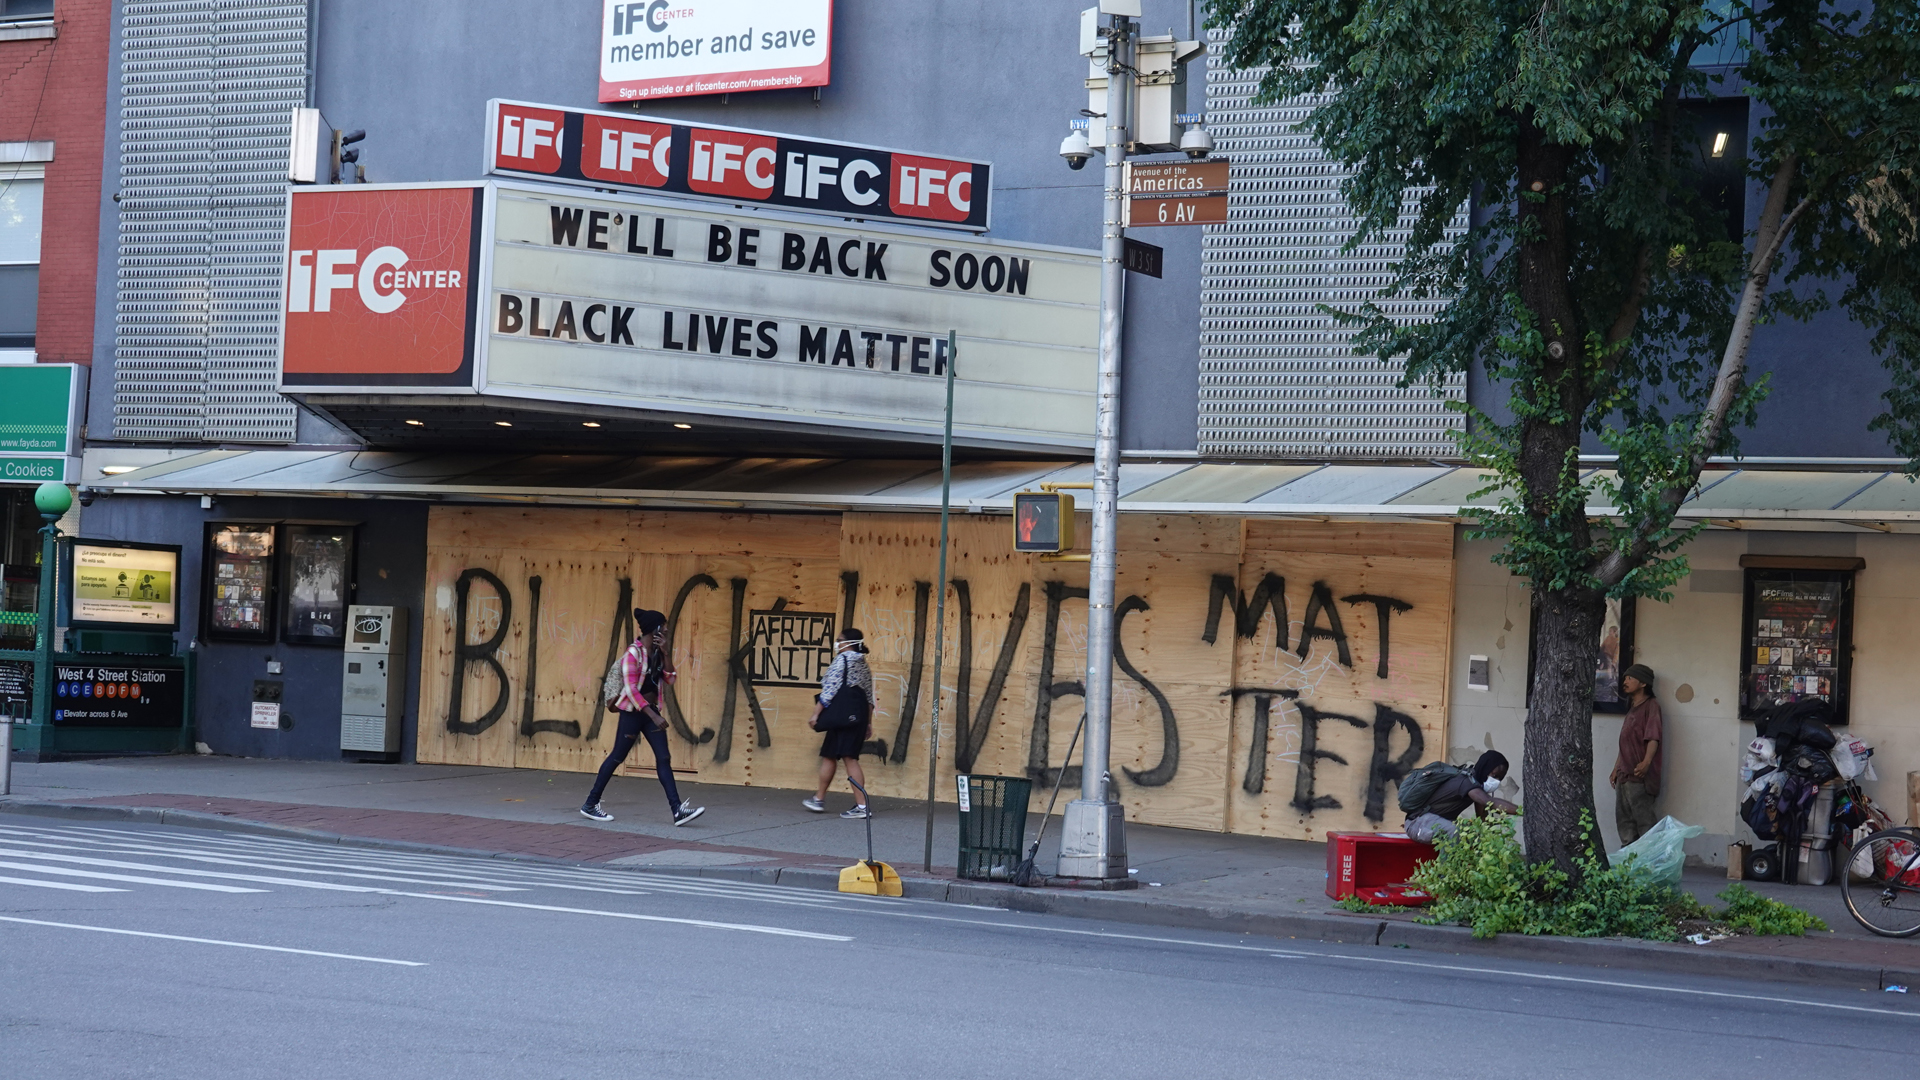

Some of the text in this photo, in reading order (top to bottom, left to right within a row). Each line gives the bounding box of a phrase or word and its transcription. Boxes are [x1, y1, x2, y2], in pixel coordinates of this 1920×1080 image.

[656, 9, 694, 20] CENTER
[610, 28, 816, 63] member and save
[619, 88, 635, 98] Sign
[636, 88, 649, 97] up
[650, 84, 674, 95] inside
[685, 85, 694, 93] at
[695, 75, 802, 91] ifccenter.com/membership
[1072, 120, 1089, 129] NYP
[1177, 114, 1199, 123] NYPD
[501, 115, 563, 160] IF
[1133, 167, 1187, 177] Avenue of the
[1133, 175, 1203, 191] Americas
[1158, 203, 1195, 222] 6 Av
[550, 205, 1030, 295] WE'LL BE BACK SOON
[1129, 248, 1153, 273] W 3 St
[380, 270, 461, 289] CENTER
[498, 294, 957, 377] BLACK LIVES MATTER
[1, 438, 57, 449] www.fayda.com
[6, 462, 54, 477] Cookies
[310, 611, 332, 620] Bird
[752, 615, 832, 646] AFRICA
[446, 567, 787, 762] BLACK
[1201, 571, 1414, 679] MAT
[751, 646, 831, 682] UNITE
[58, 668, 166, 683] West 4 Street Station
[64, 710, 87, 718] Elevator
[111, 710, 116, 718] 6
[117, 710, 128, 718] Ave
[1219, 687, 1424, 822] TER
[1343, 855, 1352, 882] FREE
